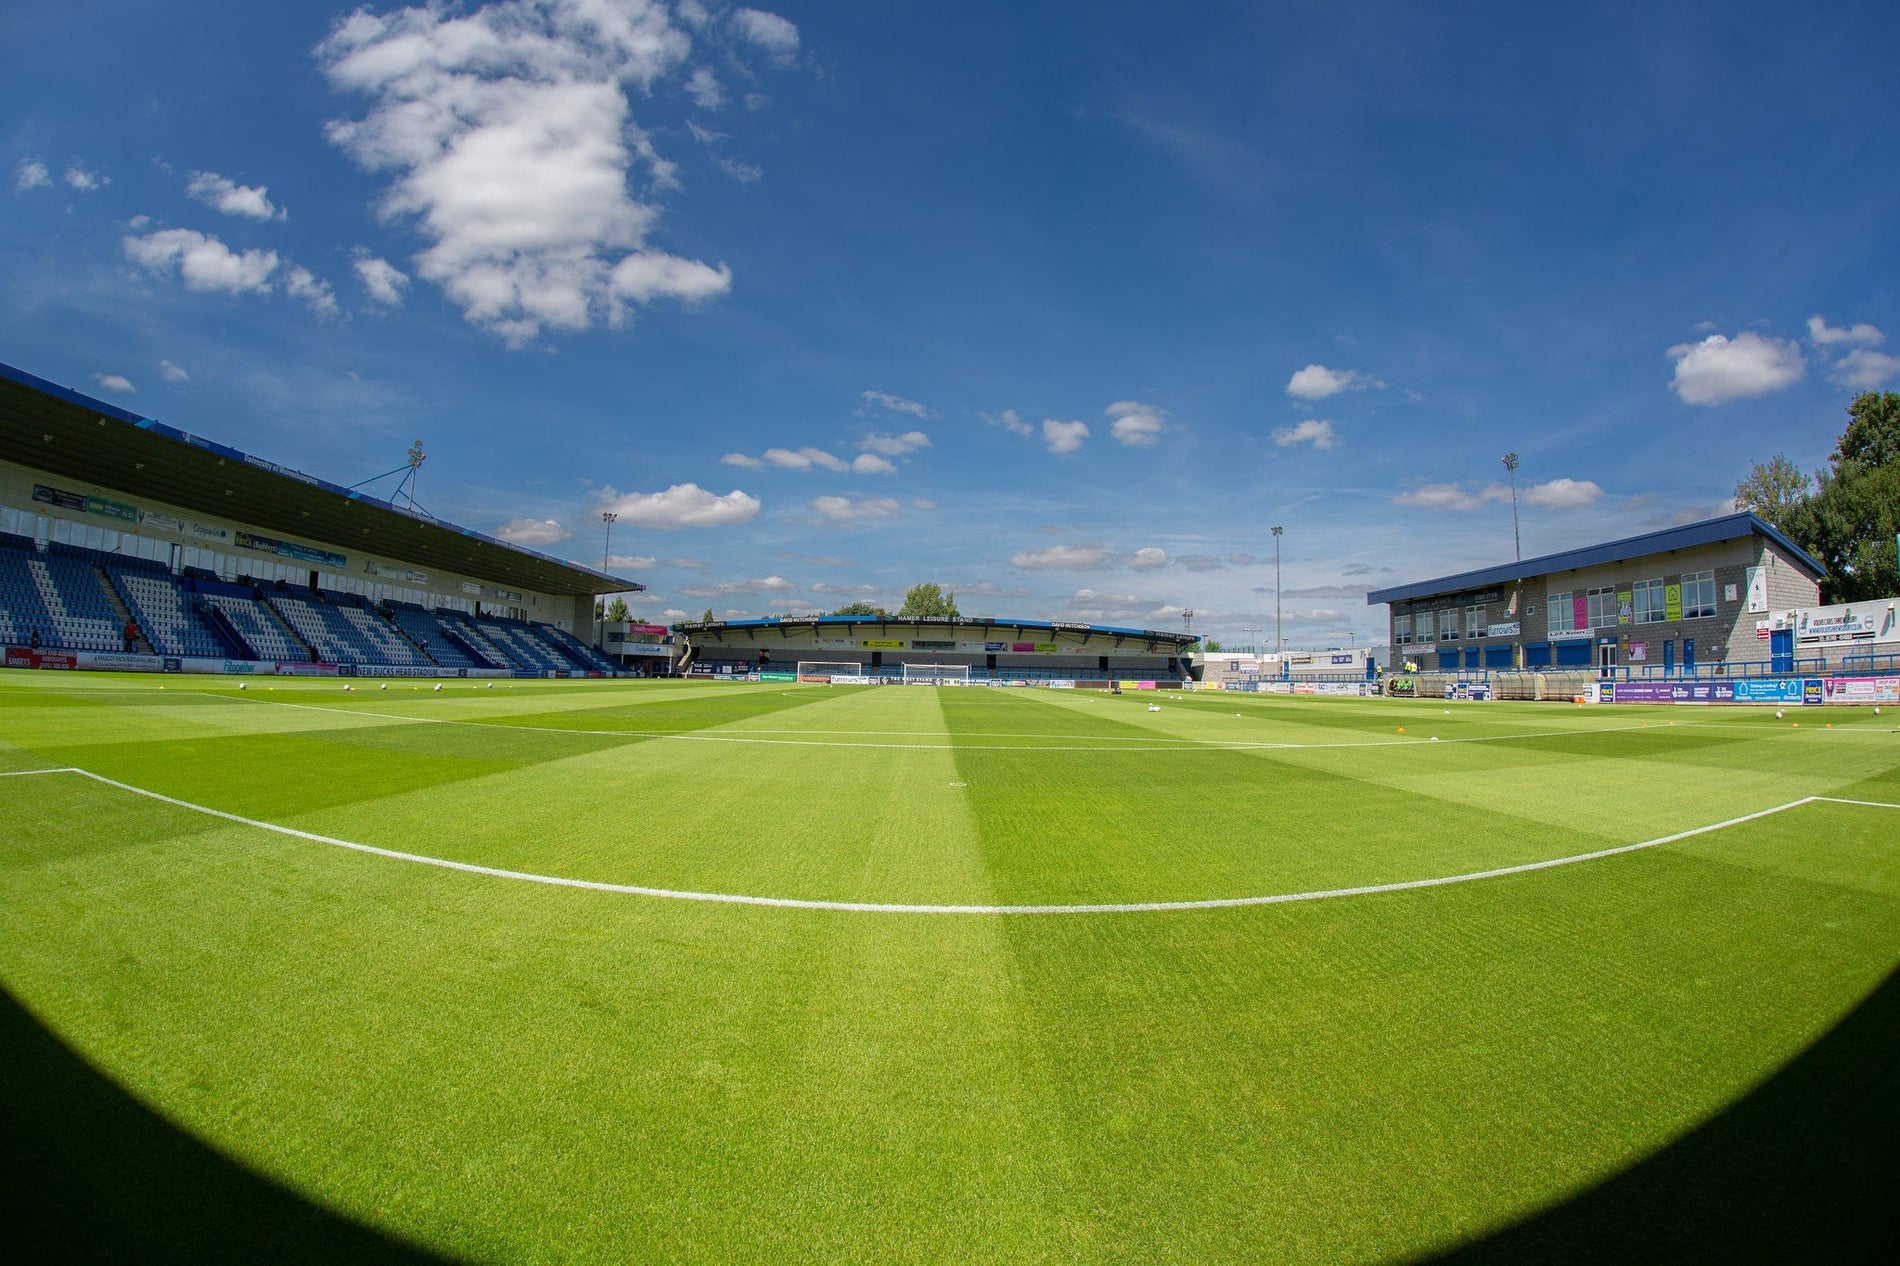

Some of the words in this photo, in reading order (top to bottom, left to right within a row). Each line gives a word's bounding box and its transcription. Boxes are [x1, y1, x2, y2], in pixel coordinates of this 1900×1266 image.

[1824, 617, 1834, 625] CARS
[357, 666, 373, 676] NEW
[374, 666, 394, 676] BUCKS
[395, 667, 412, 676] HEAD
[413, 667, 438, 676] STADIUM
